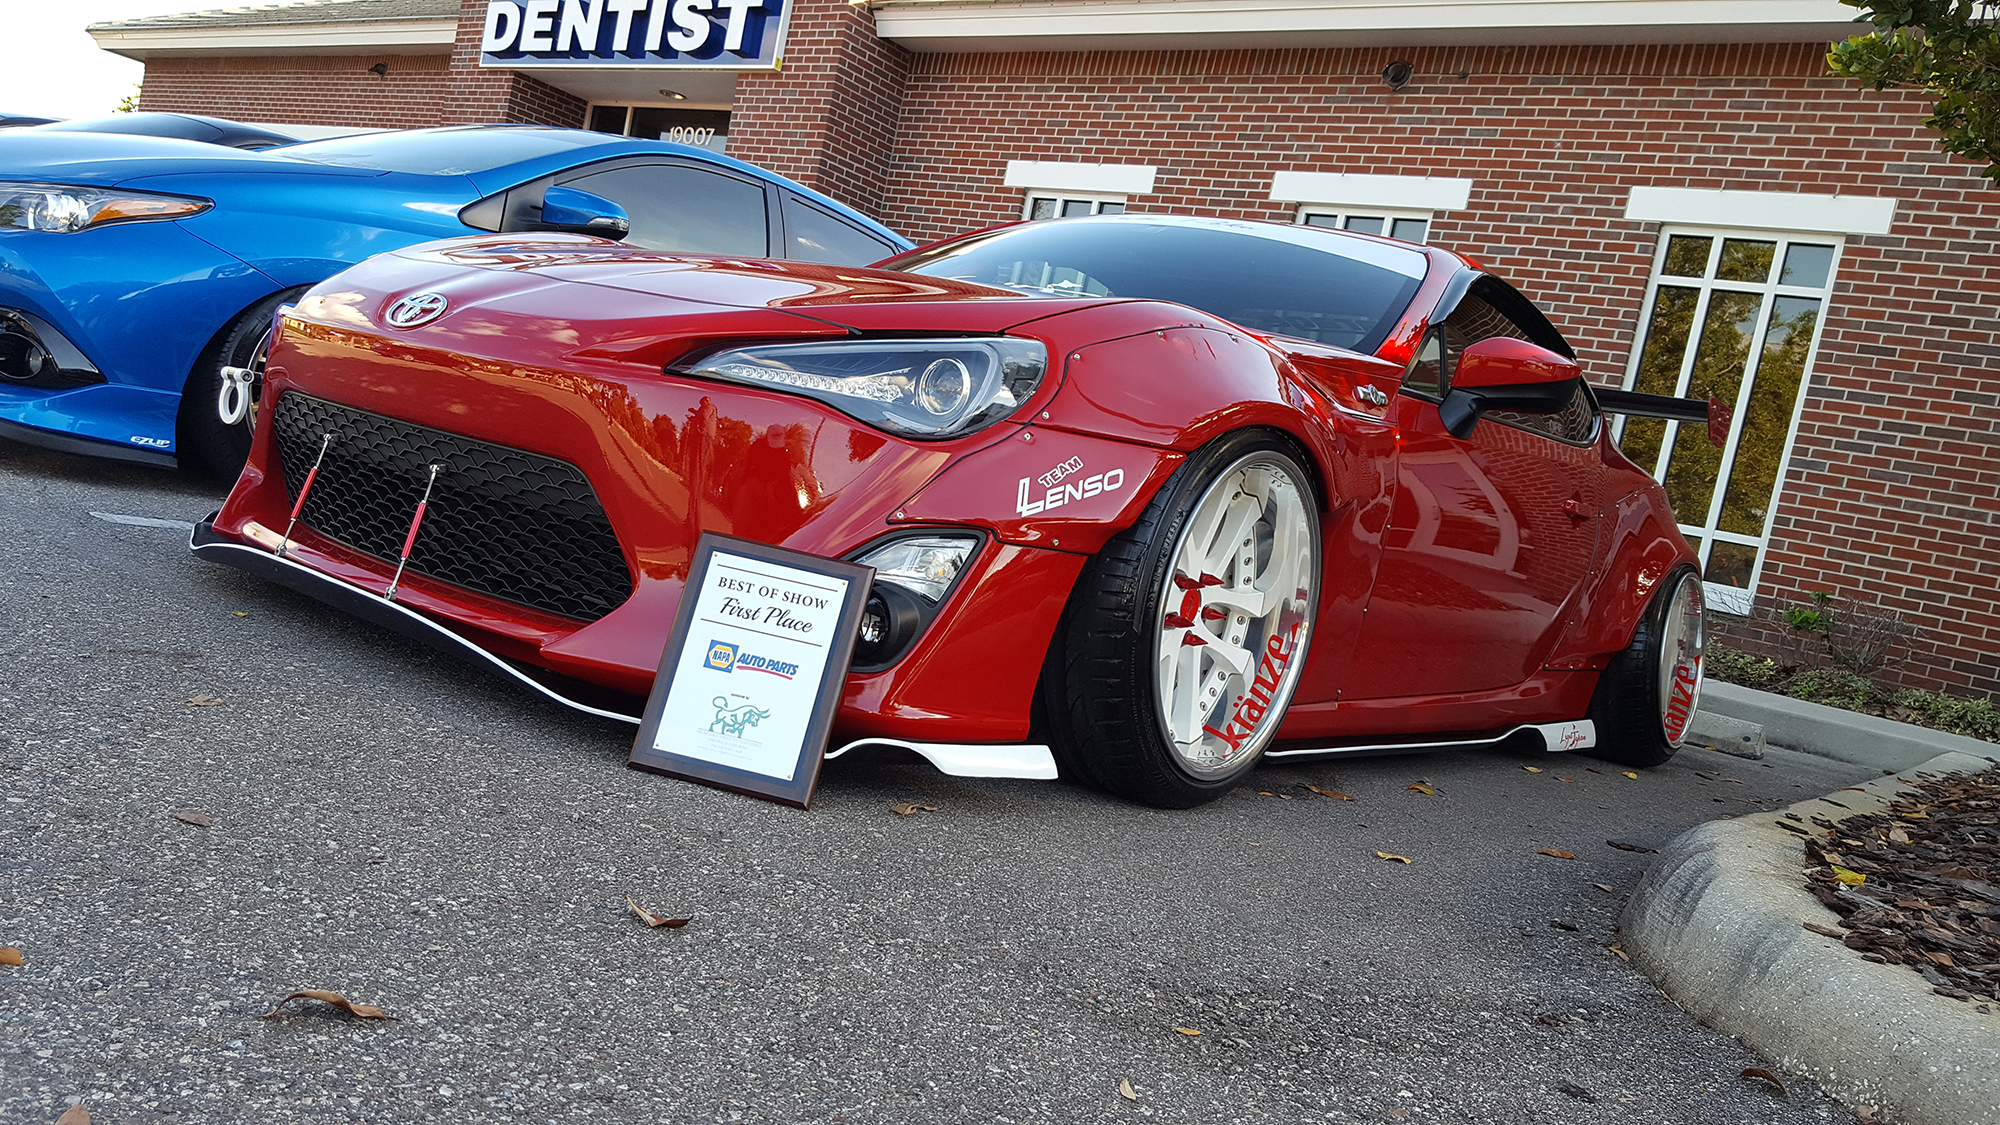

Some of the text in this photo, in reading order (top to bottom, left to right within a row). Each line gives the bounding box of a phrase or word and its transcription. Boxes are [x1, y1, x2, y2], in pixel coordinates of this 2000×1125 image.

[482, 0, 764, 52] DENTIST
[669, 126, 715, 145] 19007
[1037, 455, 1084, 488] TEAM
[1016, 468, 1124, 518] LENSO
[718, 577, 829, 610] BEST OF SHOW
[720, 597, 813, 633] First Place
[712, 650, 799, 675] NAPA AUTO PARTS
[1202, 622, 1299, 759] kränze
